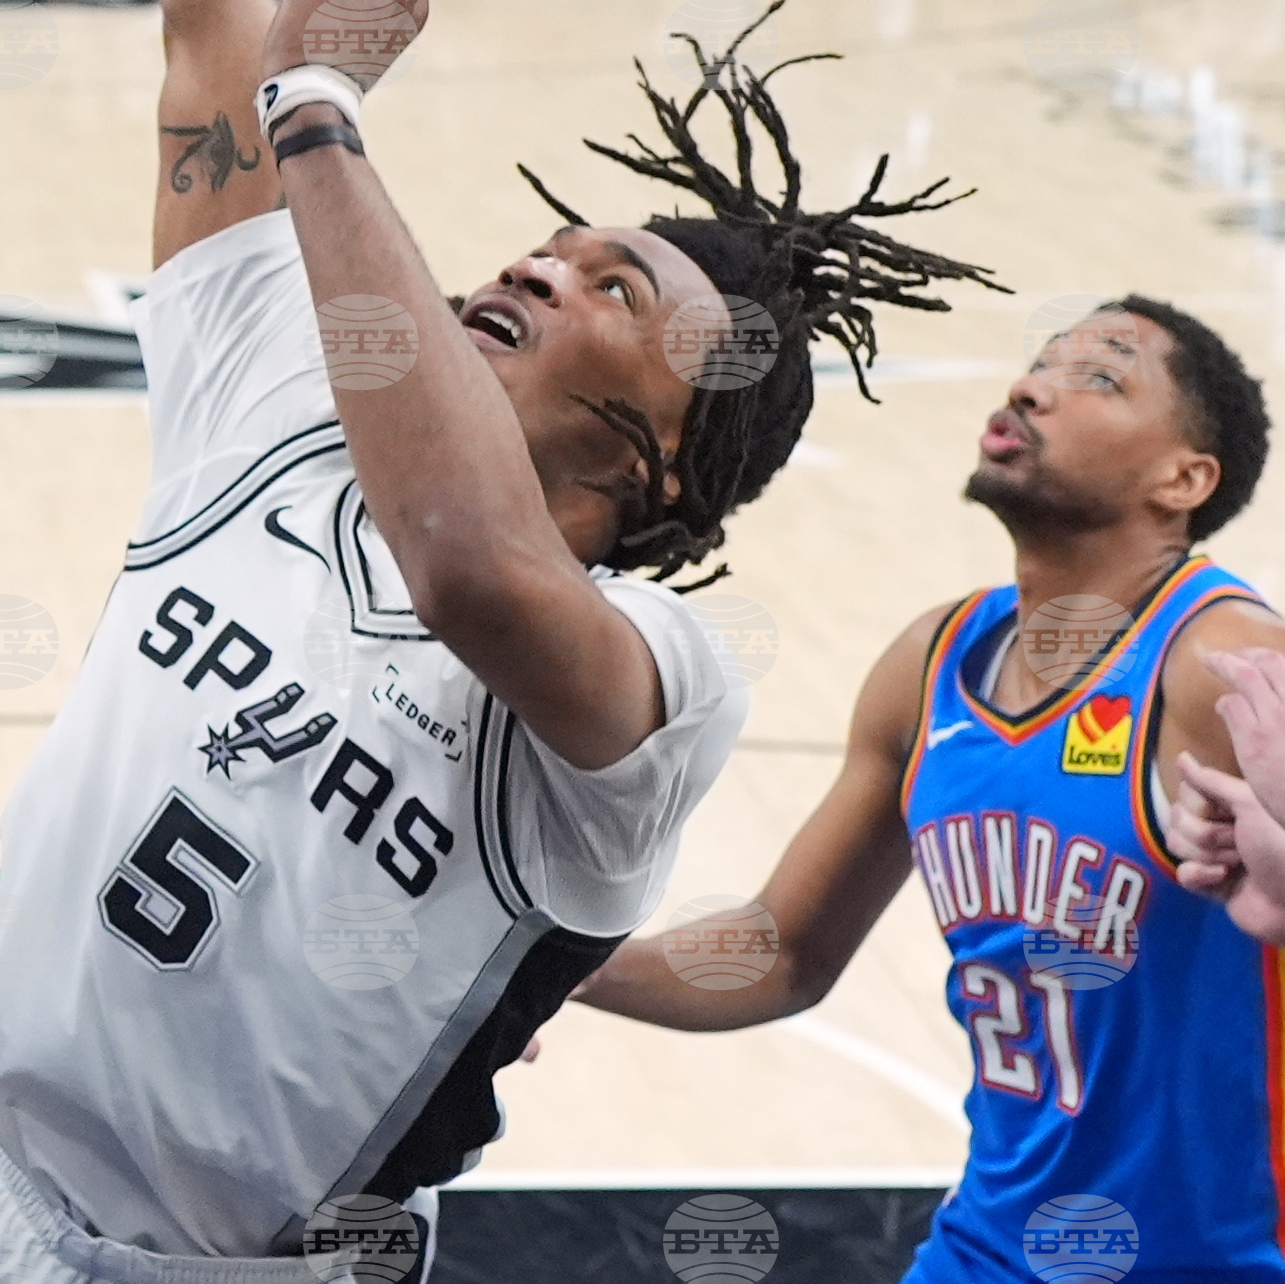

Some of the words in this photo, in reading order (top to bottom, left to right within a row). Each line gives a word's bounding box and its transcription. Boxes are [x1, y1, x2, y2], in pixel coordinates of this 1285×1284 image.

[137, 585, 454, 899] SPURS
[385, 682, 457, 747] LEDGER
[96, 785, 262, 972] 5
[915, 810, 1150, 965] HUNDER
[958, 959, 1085, 1116] 21
